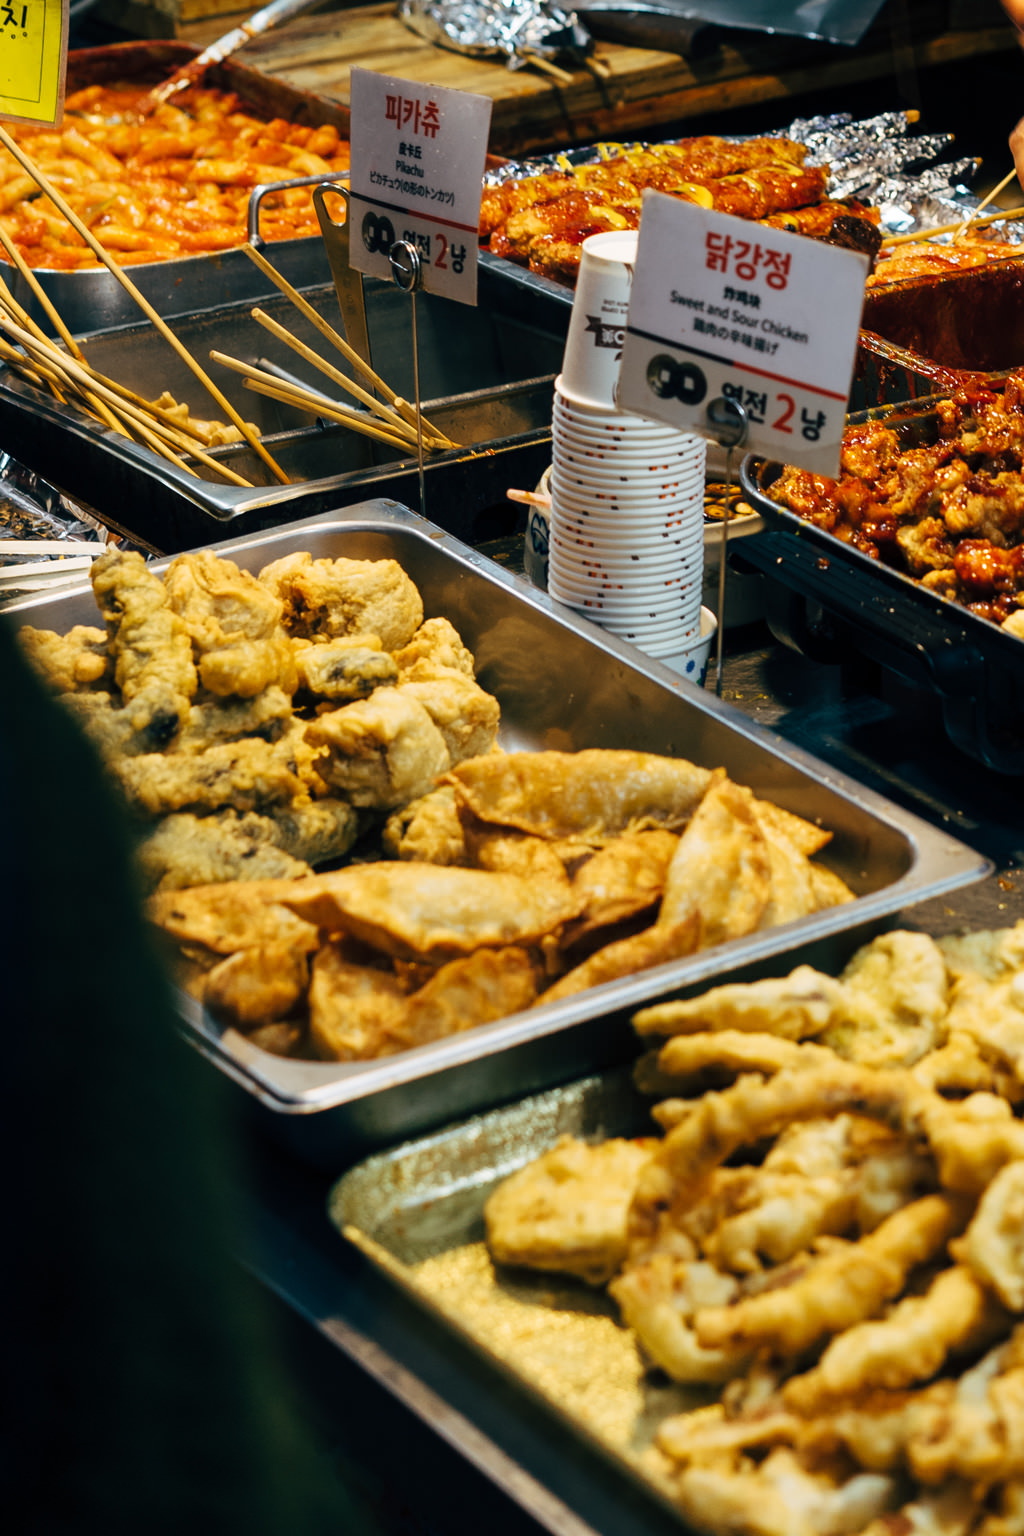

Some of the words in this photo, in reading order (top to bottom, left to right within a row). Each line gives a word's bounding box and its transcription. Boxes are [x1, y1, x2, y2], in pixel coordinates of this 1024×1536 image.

[385, 94, 441, 138] 피카츄
[395, 160, 424, 178] Pikachu
[705, 231, 792, 291] 닭강정
[670, 290, 705, 313] Sweet
[706, 303, 731, 323] and
[732, 312, 761, 330] Sour
[761, 318, 809, 345] Chicken
